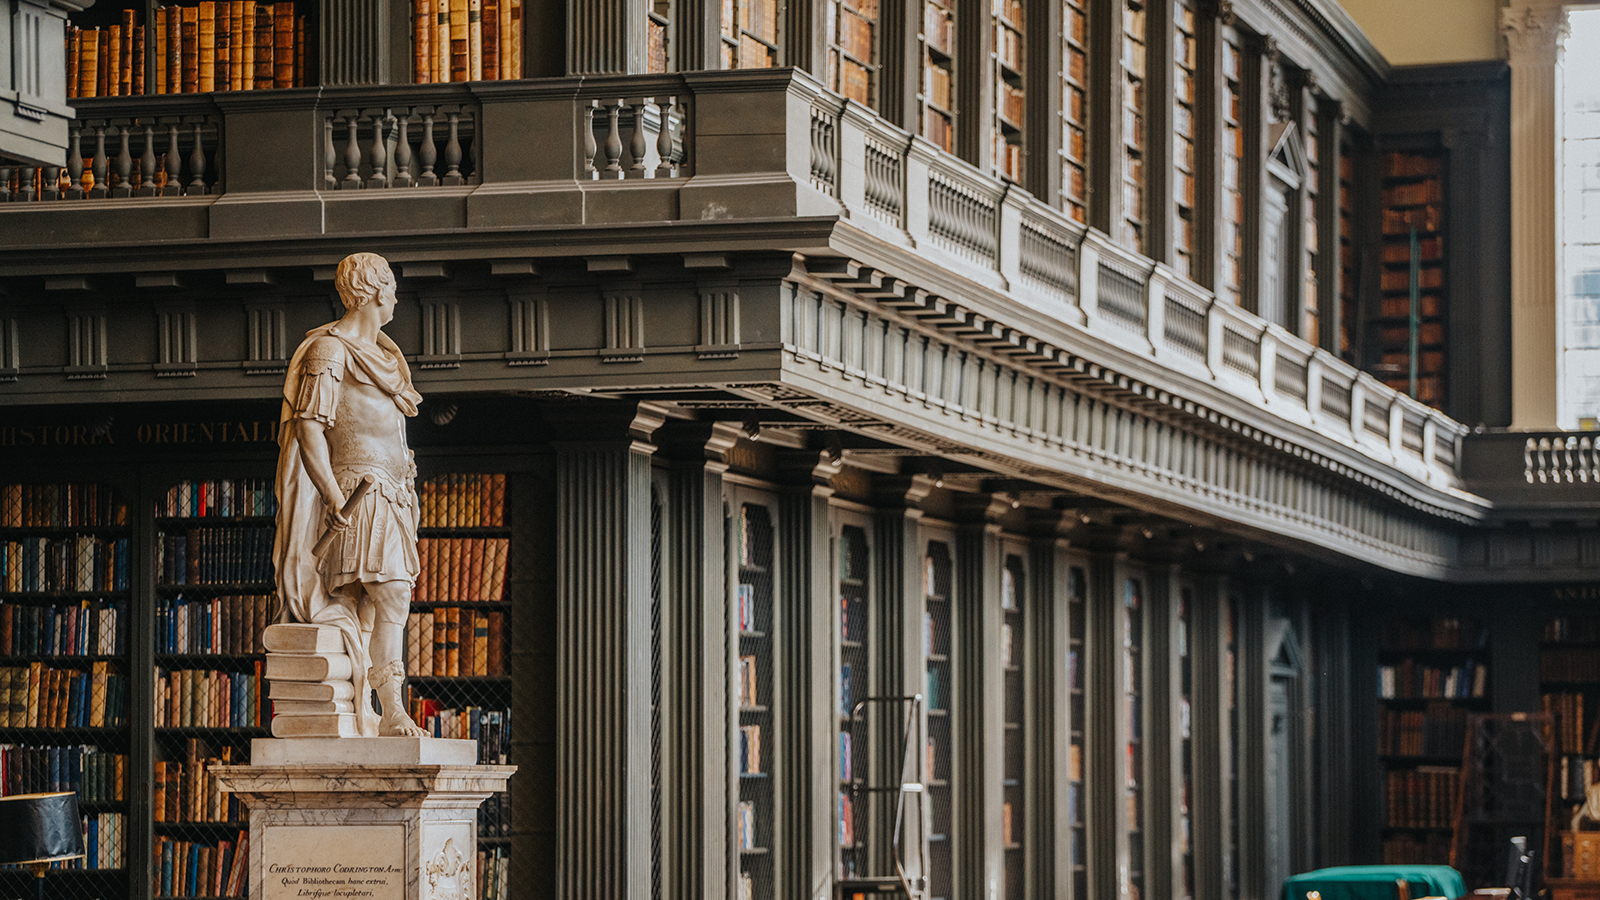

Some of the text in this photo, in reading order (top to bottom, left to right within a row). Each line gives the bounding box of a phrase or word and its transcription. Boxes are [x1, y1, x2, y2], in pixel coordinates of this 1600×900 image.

[269, 863, 332, 874] CHRISTOPHORO
[333, 863, 385, 874] CODRINGTON
[302, 877, 346, 885] Bibliothecam
[347, 877, 365, 885] hanc
